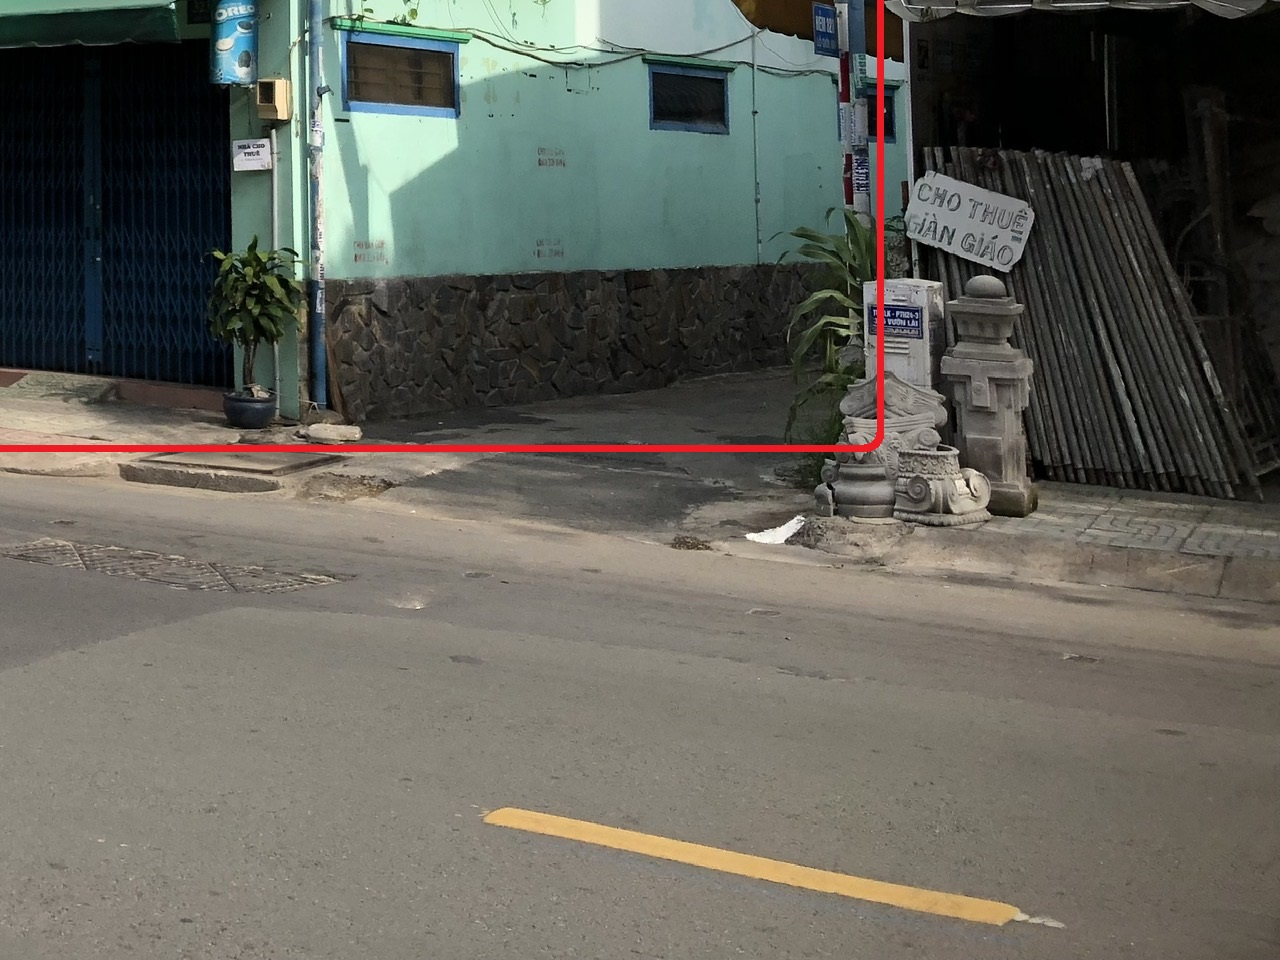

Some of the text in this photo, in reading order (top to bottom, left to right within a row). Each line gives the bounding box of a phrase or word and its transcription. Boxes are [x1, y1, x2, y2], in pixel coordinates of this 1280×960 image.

[215, 5, 255, 21] OREO
[917, 183, 1028, 236] CHO THUÊ
